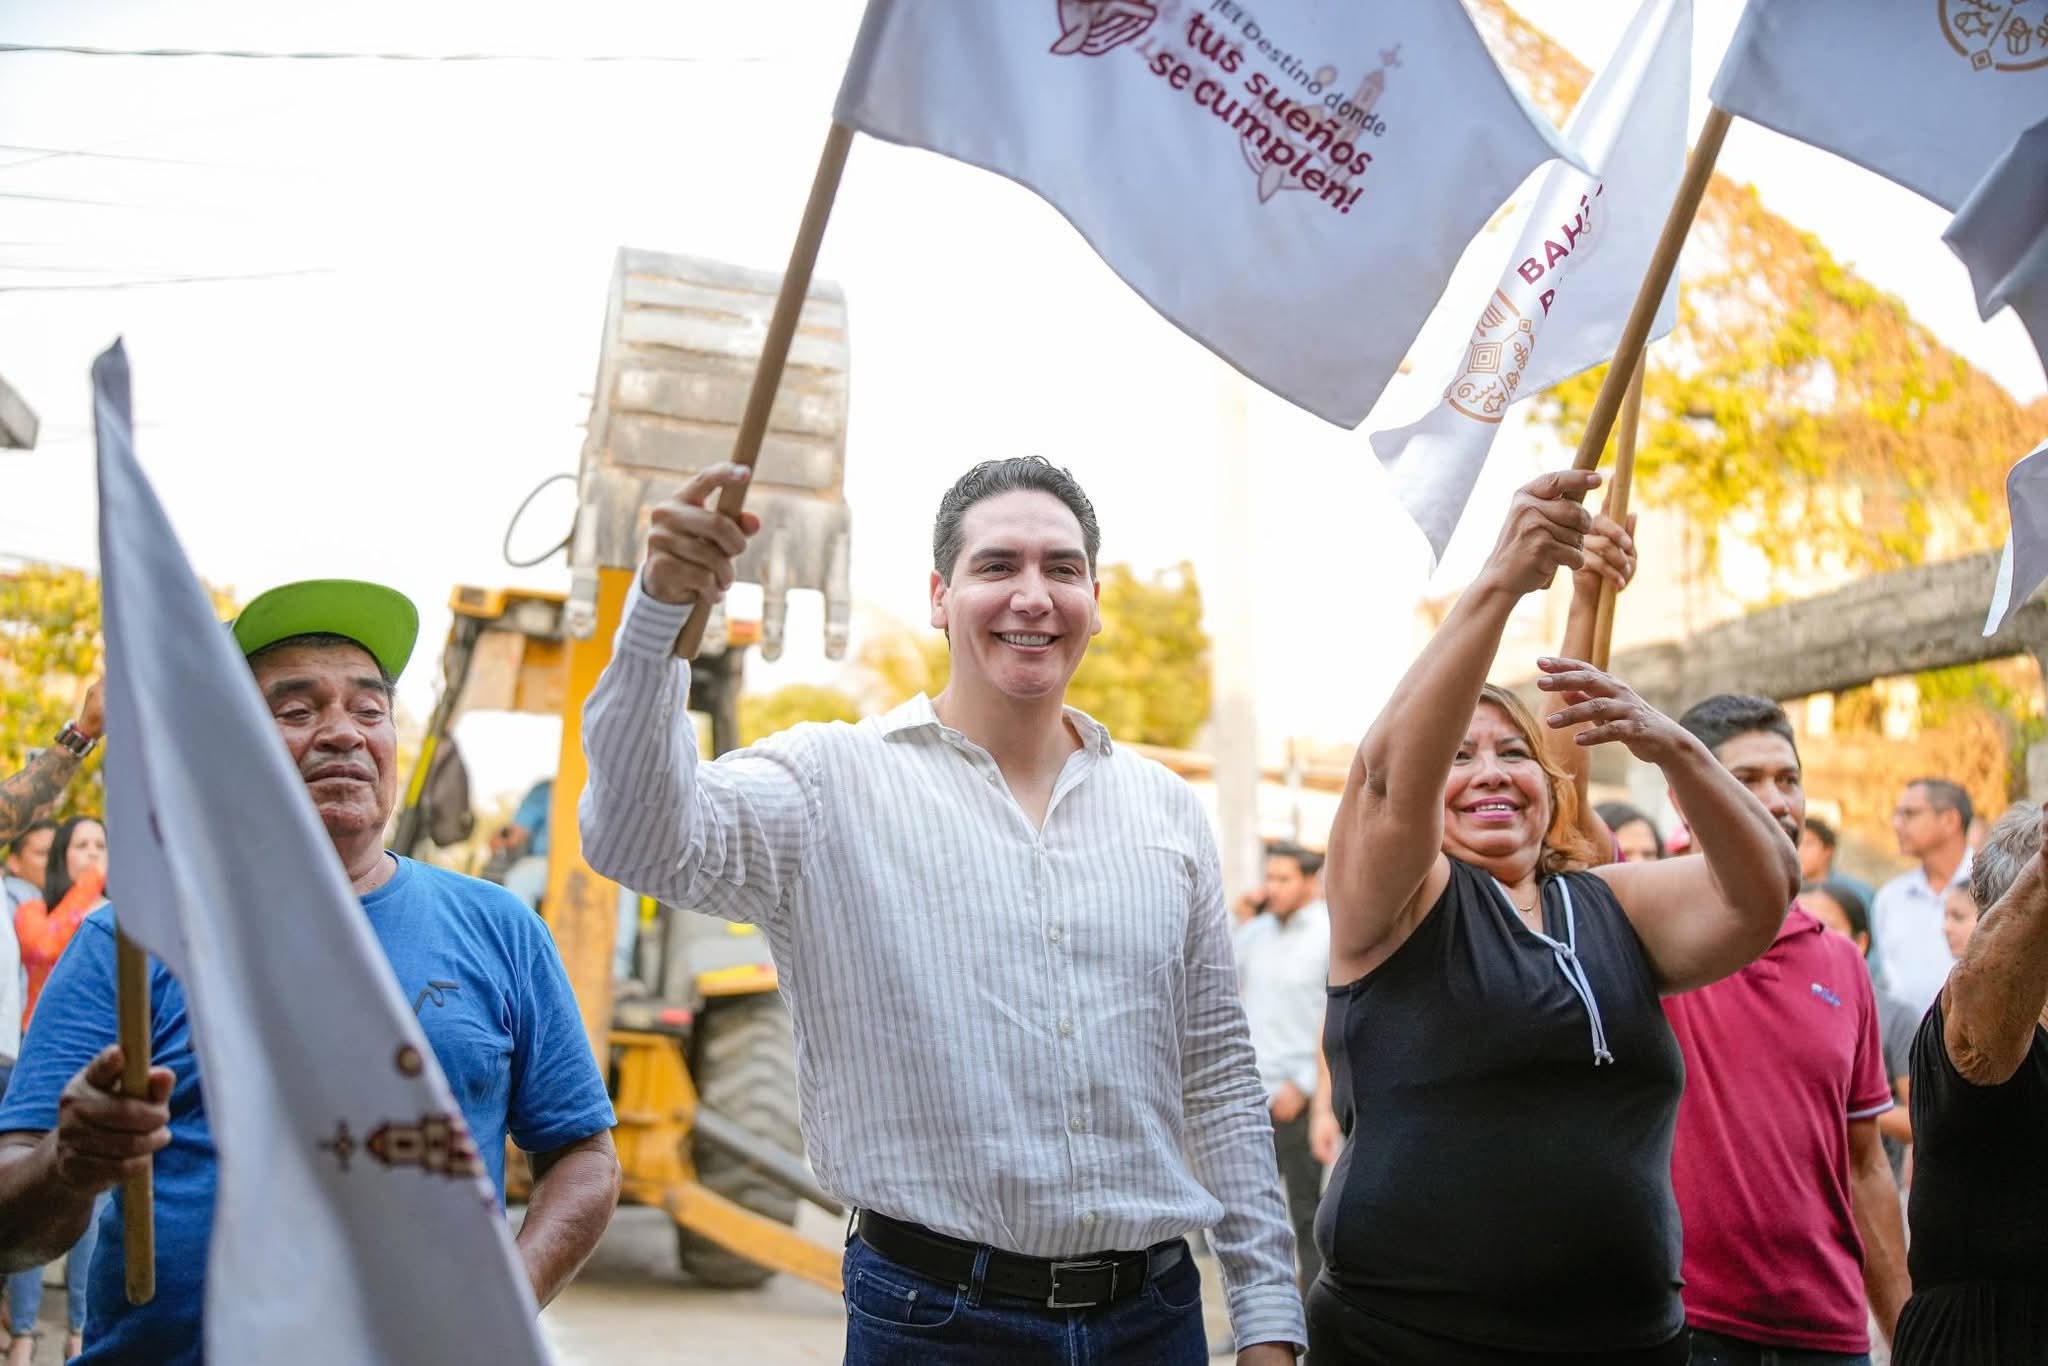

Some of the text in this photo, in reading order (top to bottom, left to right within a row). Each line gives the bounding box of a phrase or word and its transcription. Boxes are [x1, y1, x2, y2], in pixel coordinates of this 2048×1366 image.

[1148, 52, 1364, 214] se cumplen!
[1186, 12, 1373, 176] tus sueños
[1242, 22, 1323, 96] Destino
[1324, 92, 1387, 137] donde
